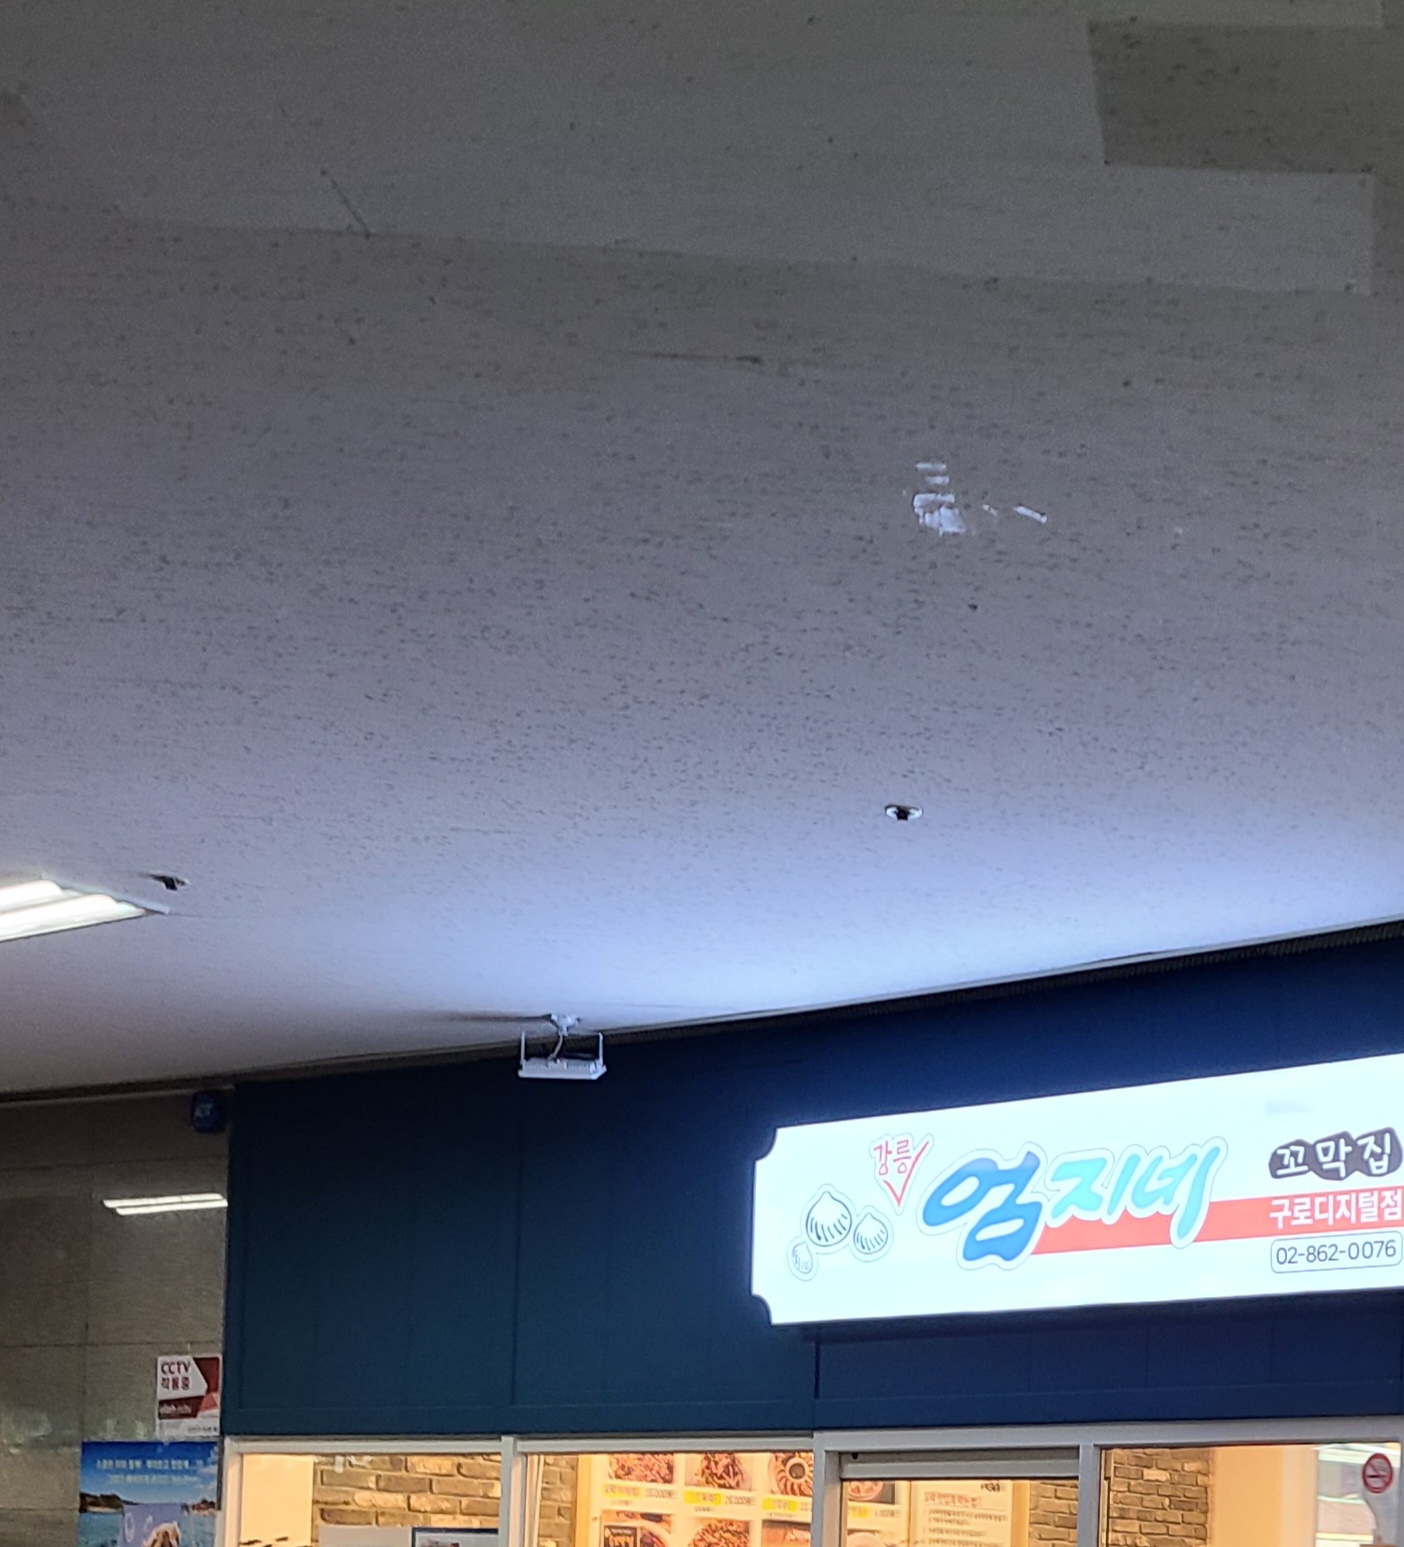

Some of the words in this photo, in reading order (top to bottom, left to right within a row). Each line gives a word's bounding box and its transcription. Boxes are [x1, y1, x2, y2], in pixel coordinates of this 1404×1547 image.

[872, 1138, 914, 1178] 강릉
[1277, 1134, 1397, 1178] 꼬막집
[922, 1147, 1221, 1261] 엄지네
[1269, 1189, 1402, 1231] 구로디지털점
[1275, 1239, 1397, 1267] 02-862-0076
[161, 1361, 190, 1375] CCTV
